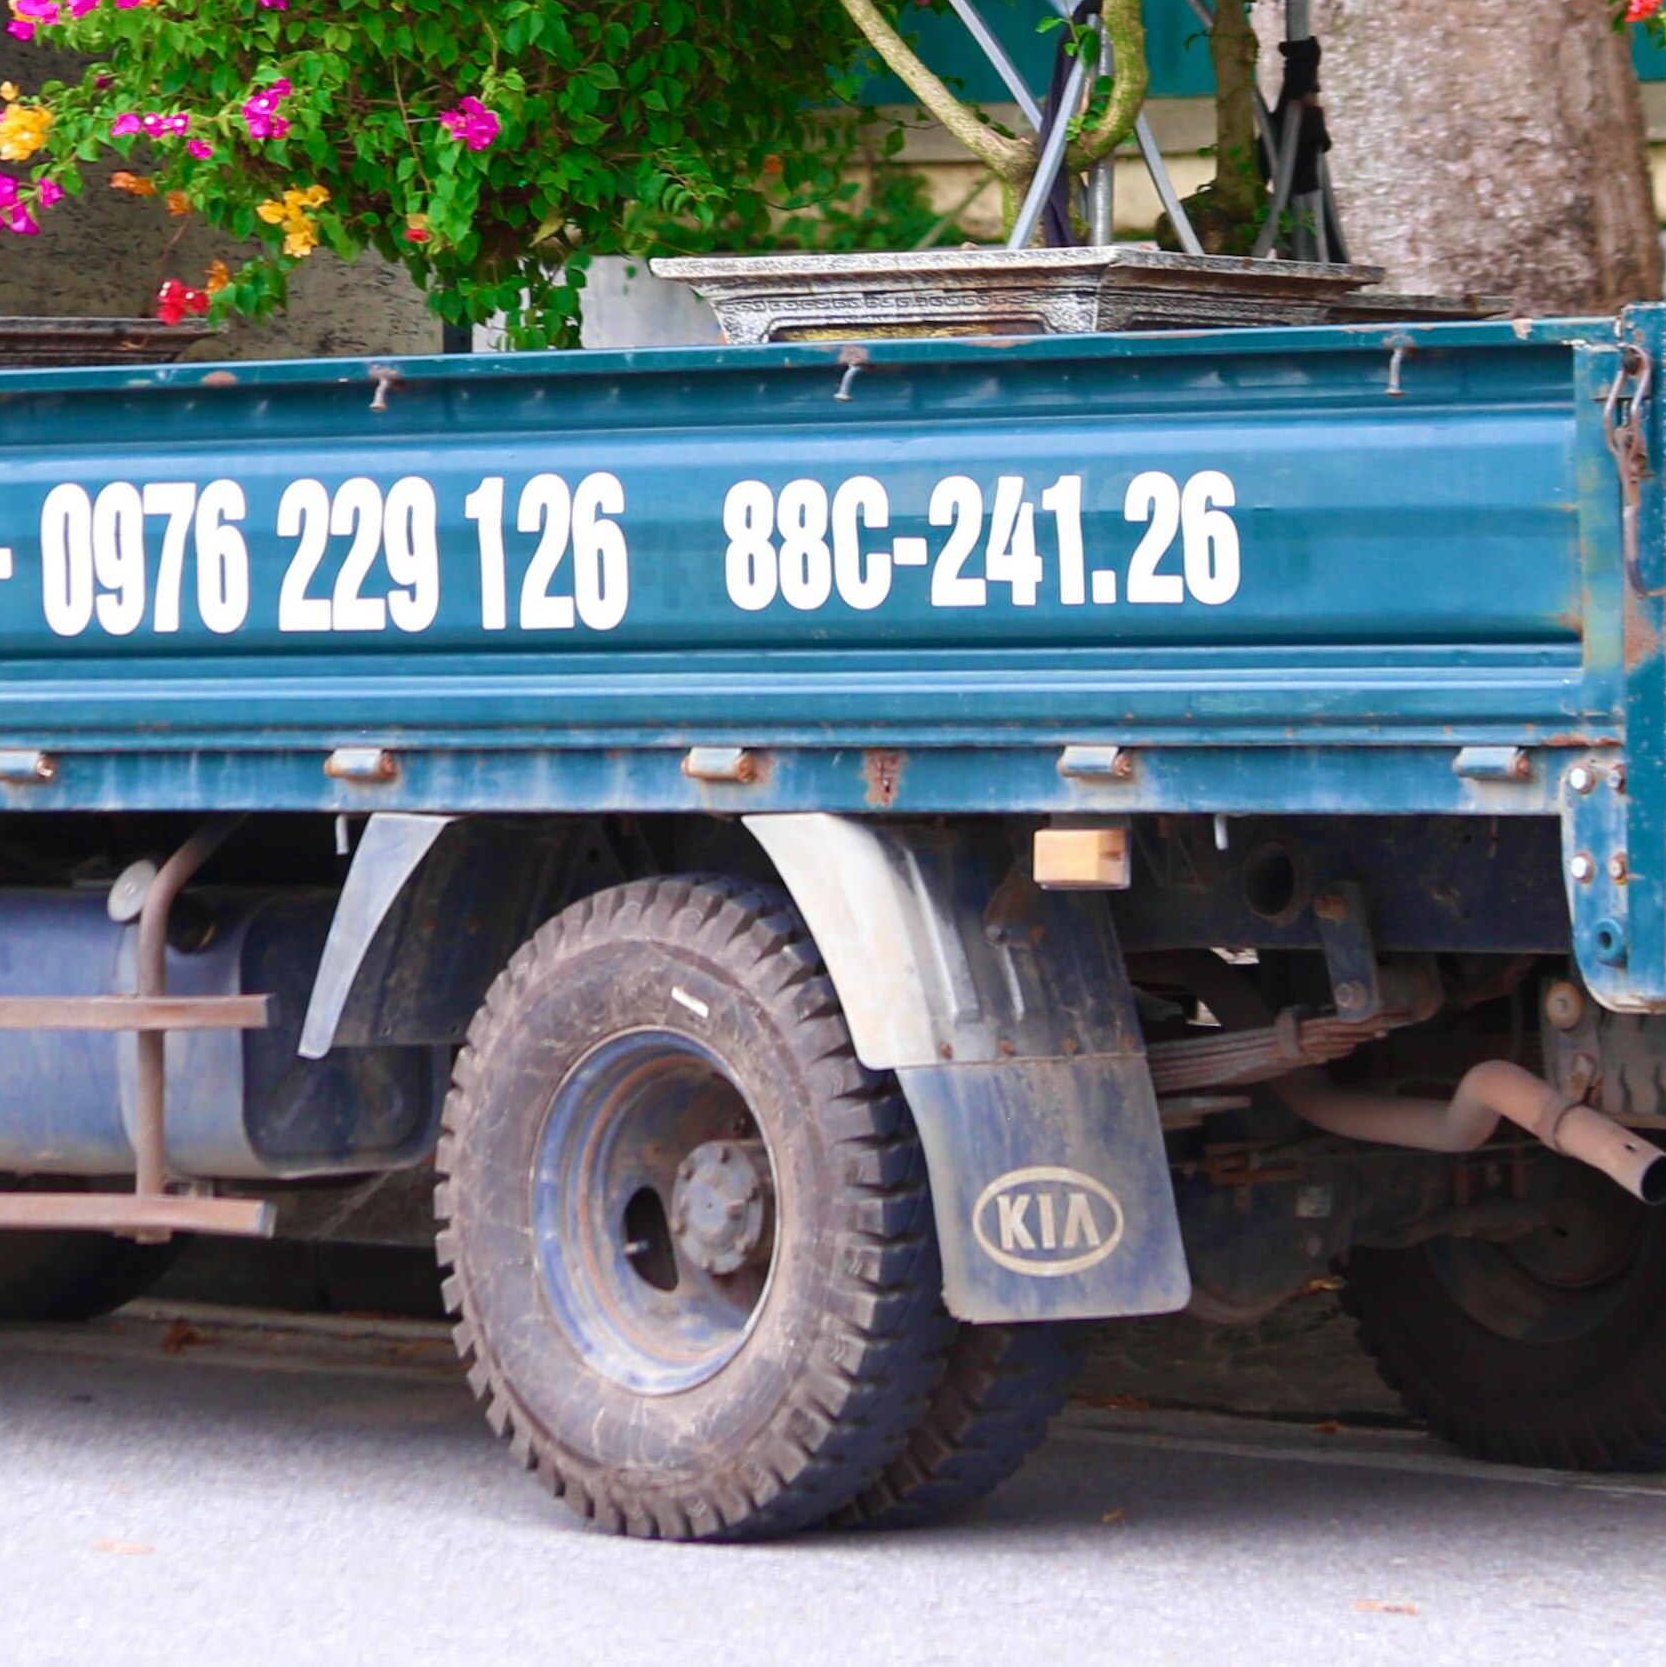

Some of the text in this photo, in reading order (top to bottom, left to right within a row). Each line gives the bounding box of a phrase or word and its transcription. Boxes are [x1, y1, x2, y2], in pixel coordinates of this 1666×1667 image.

[40, 478, 251, 637] 0976
[276, 475, 440, 633] 229
[464, 471, 629, 631] 126
[722, 469, 1242, 611] 88C-241.26
[996, 1192, 1101, 1251] KIA
